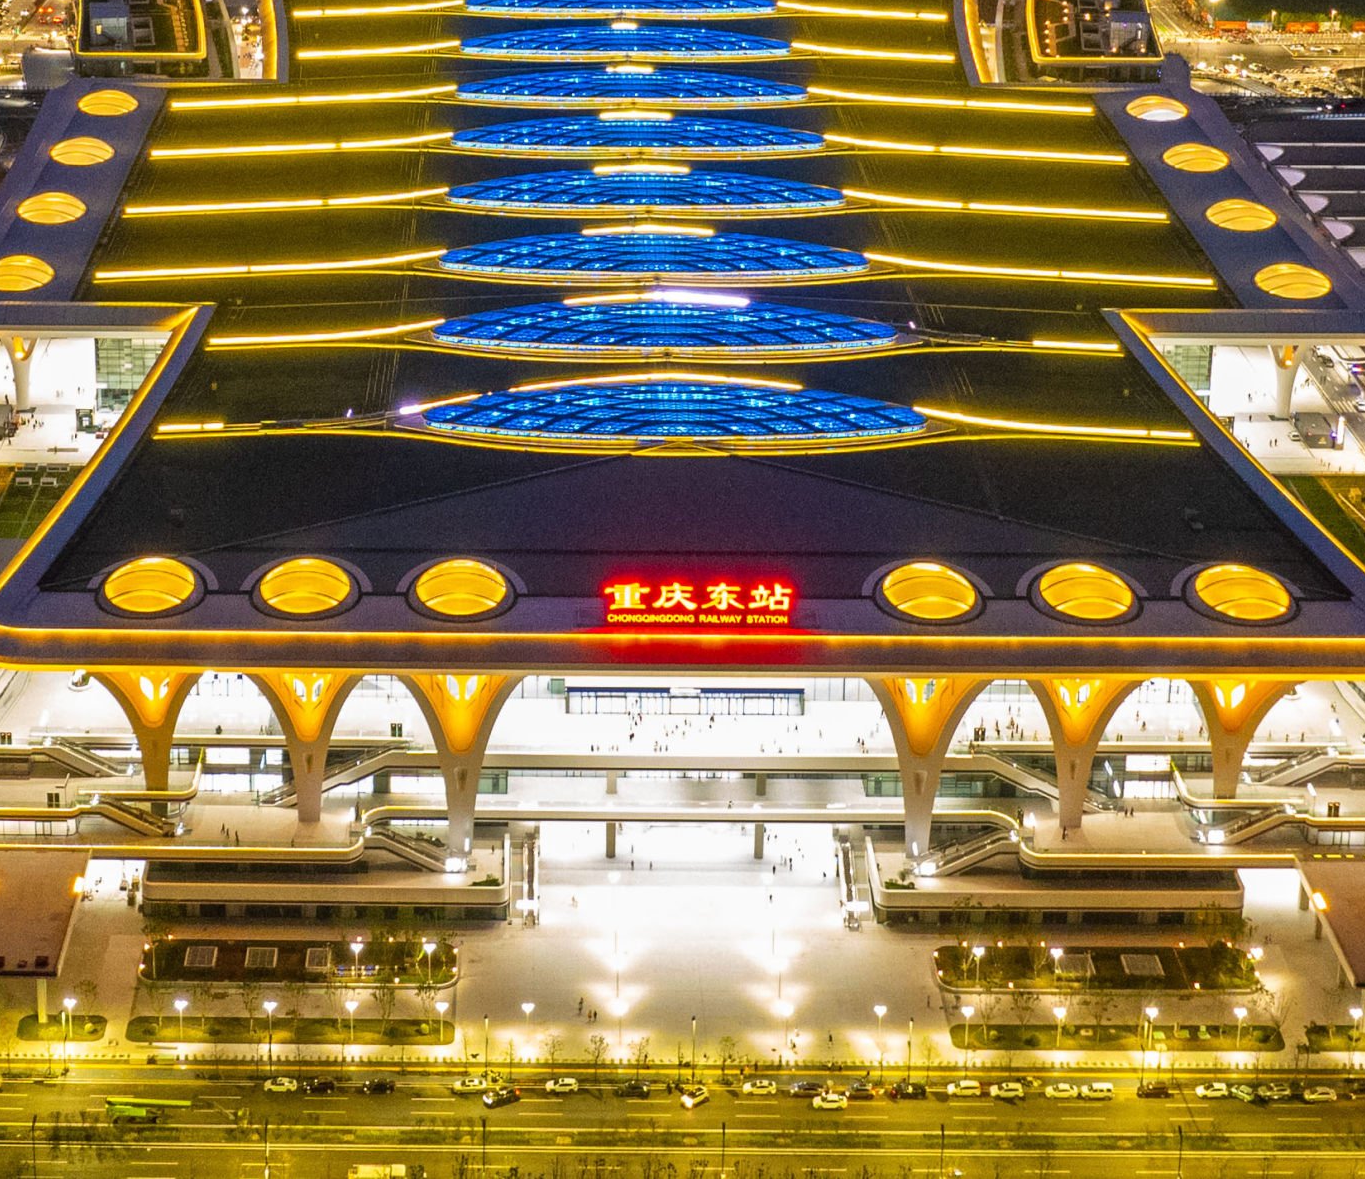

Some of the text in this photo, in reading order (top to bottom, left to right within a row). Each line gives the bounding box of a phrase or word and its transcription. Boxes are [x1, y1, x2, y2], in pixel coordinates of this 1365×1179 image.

[604, 582, 793, 611] 重庆东站
[607, 613, 788, 625] CHONGQINGDONG RAILWAY STATION
